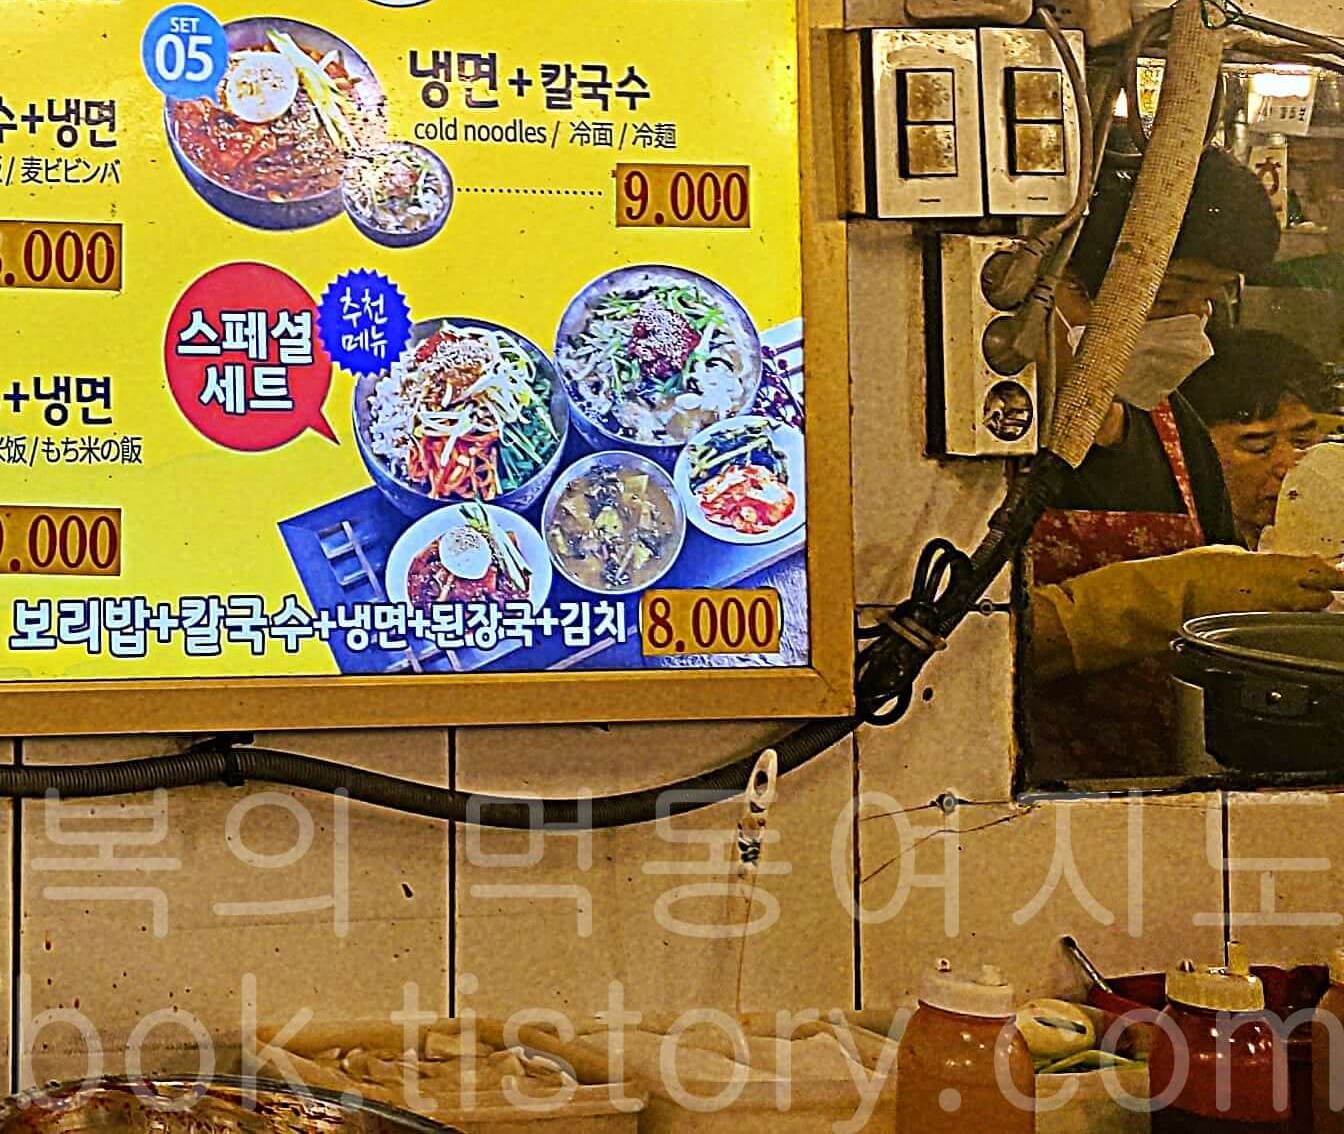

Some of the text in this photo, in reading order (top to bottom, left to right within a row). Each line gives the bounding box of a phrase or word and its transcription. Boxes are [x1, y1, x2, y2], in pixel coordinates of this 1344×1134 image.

[170, 16, 200, 34] SET
[154, 33, 214, 82] 05
[414, 117, 458, 142] cold
[463, 119, 547, 144] noodles
[624, 170, 748, 227] 9.000
[339, 286, 388, 328] 추천
[176, 308, 314, 365] 스페셜
[342, 326, 388, 359] 메뉴
[199, 364, 295, 415] 세트
[647, 596, 776, 653] 8.000
